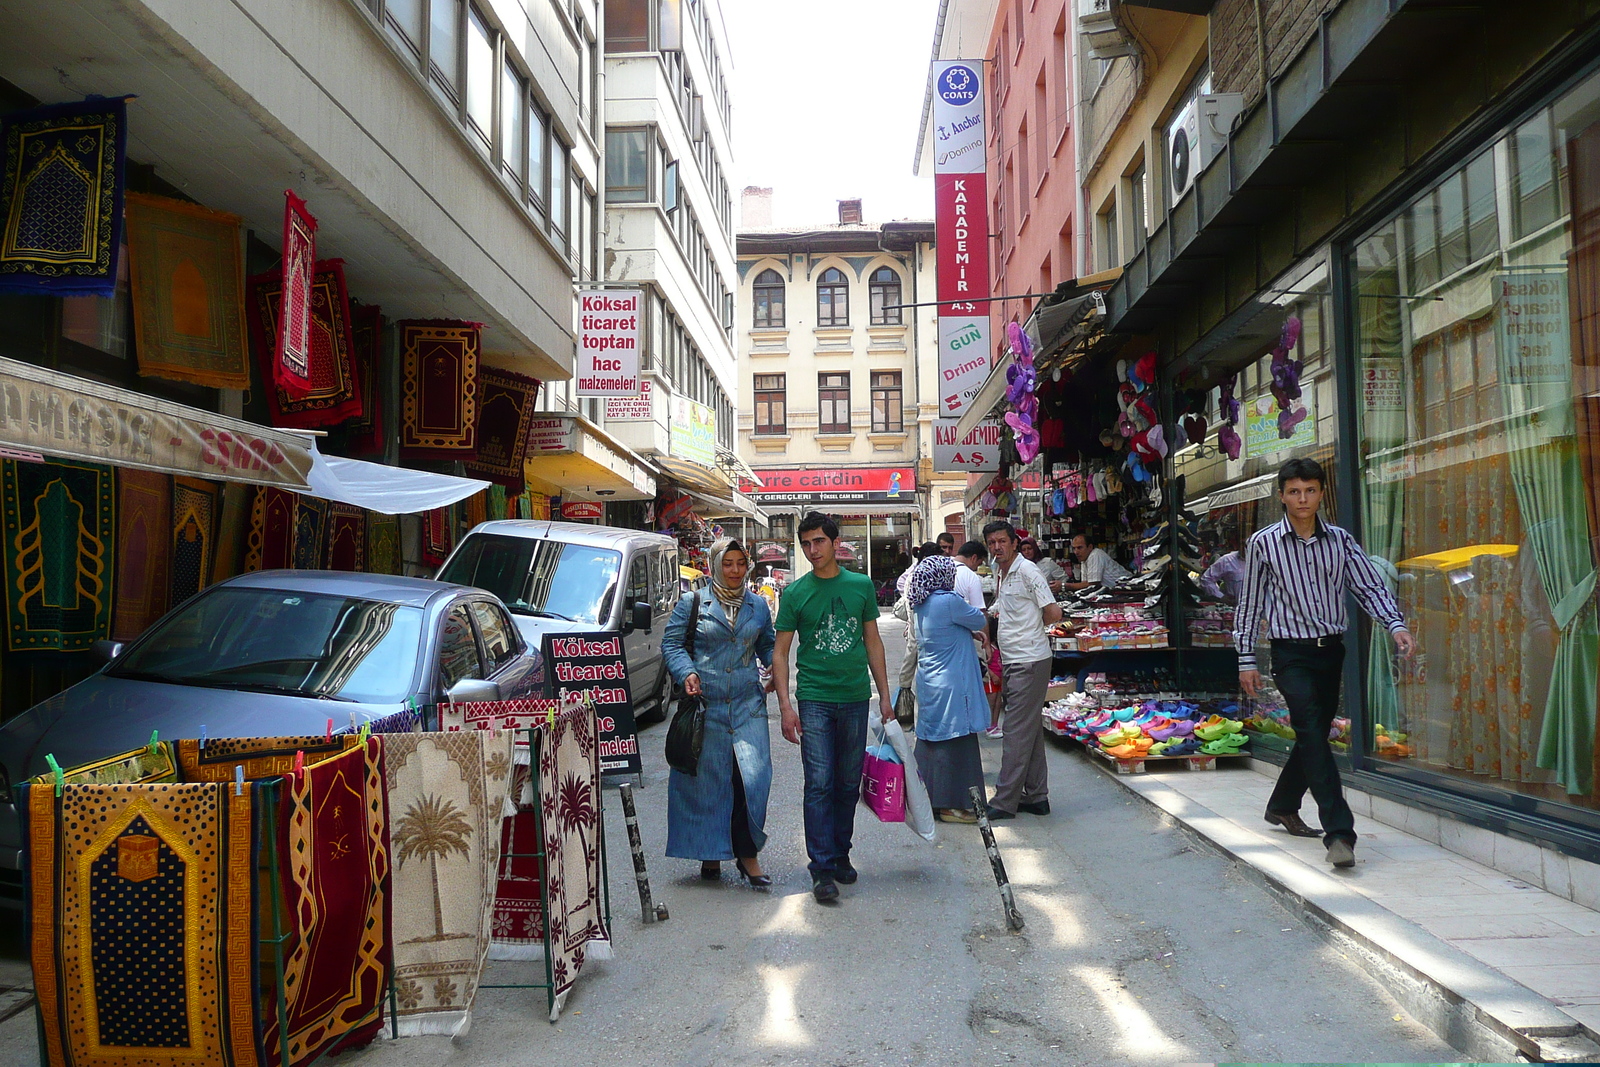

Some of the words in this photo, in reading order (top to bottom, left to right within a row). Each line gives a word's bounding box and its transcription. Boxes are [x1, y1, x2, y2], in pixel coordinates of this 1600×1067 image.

[942, 91, 974, 99] COATS
[951, 114, 981, 135] Anchor
[948, 139, 982, 160] Domino
[954, 180, 970, 292] KARADEMİR
[582, 295, 637, 312] Köksal
[582, 314, 636, 330] ticaret
[582, 333, 635, 352] toptan
[950, 330, 982, 351] GUN
[592, 356, 622, 371] hac
[942, 356, 986, 382] Drima
[578, 375, 636, 391] malzemeleri
[935, 421, 1000, 446] KARDEMİR
[951, 452, 989, 468] A.Ş.
[800, 473, 863, 486] cardin
[552, 637, 621, 658] Köksal
[556, 660, 626, 682] ticaret
